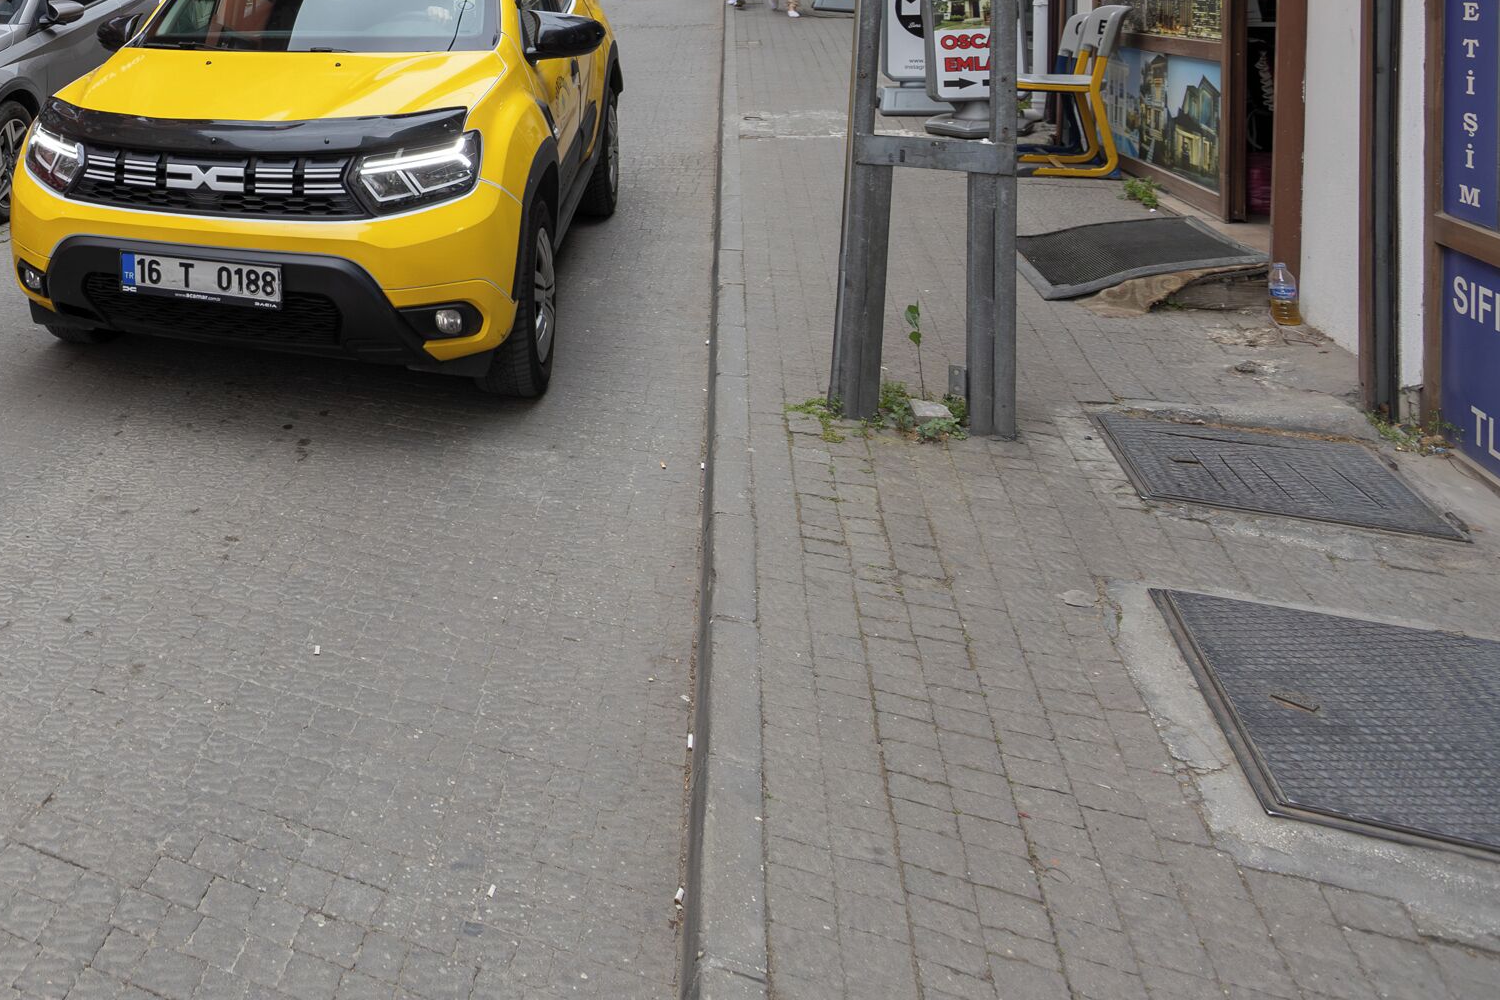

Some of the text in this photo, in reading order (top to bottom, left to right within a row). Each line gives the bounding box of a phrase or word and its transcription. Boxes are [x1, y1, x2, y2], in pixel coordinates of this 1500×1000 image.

[124, 271, 135, 280] TR
[137, 258, 276, 297] 16 T 0188
